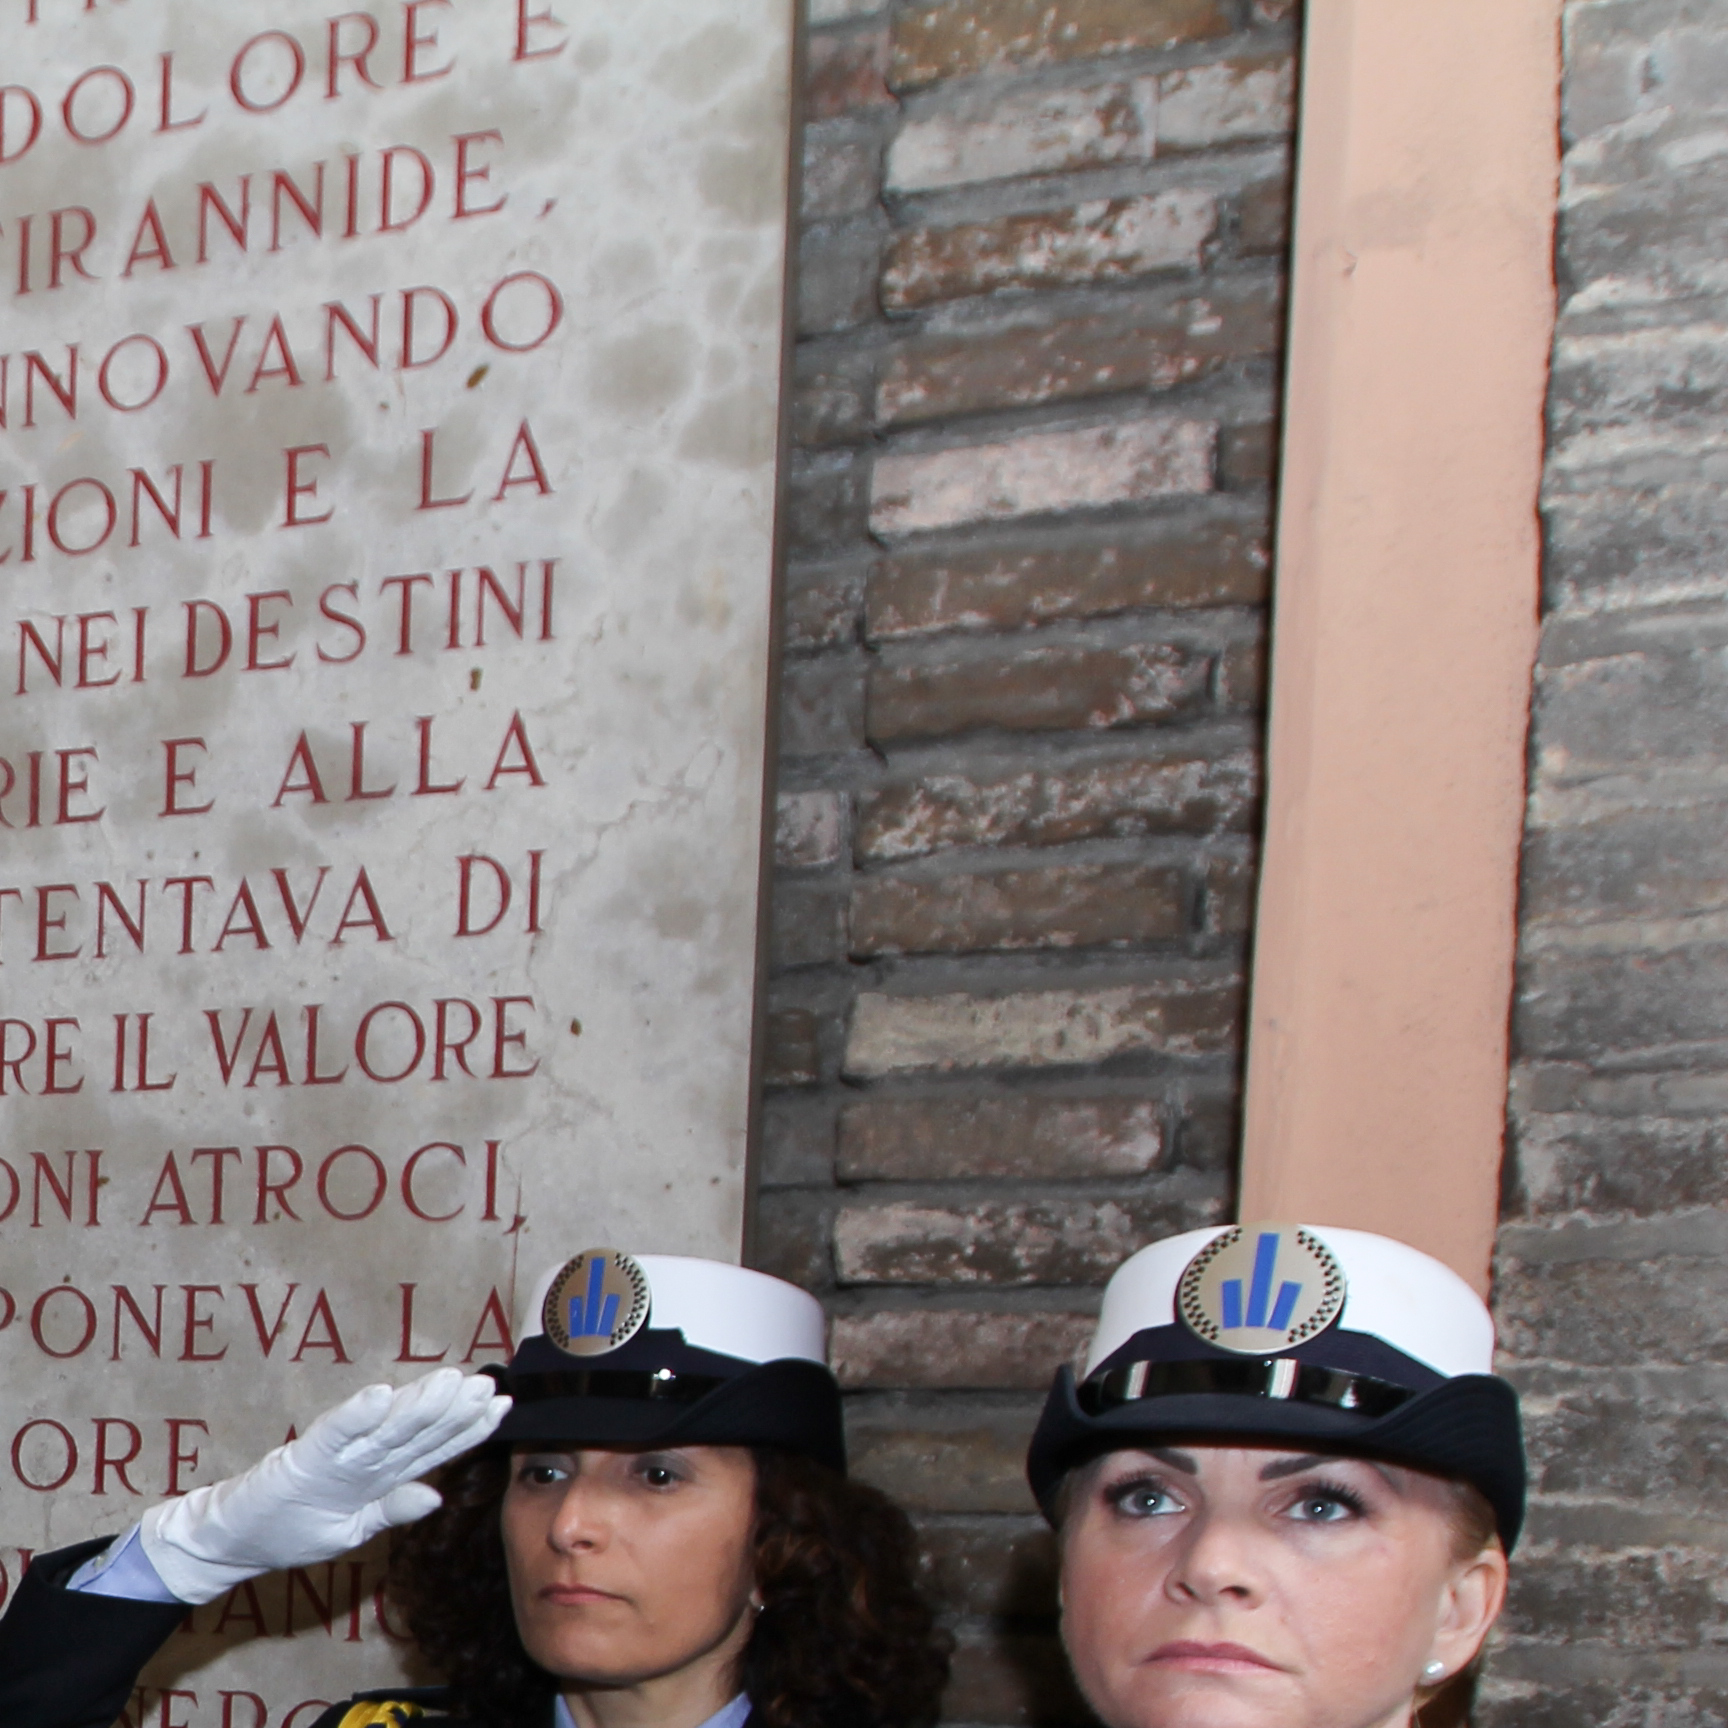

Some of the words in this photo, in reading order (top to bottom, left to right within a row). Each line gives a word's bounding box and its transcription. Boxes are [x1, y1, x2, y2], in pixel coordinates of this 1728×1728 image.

[511, 0, 563, 64] E
[280, 443, 332, 530] E
[415, 421, 551, 513] LA
[14, 608, 148, 697] NEI
[181, 561, 554, 681] DESTINI
[157, 737, 212, 819] E
[271, 711, 545, 808] ALLA
[454, 850, 543, 938] DI
[112, 1014, 176, 1093] IL
[203, 996, 538, 1089] VALORE
[139, 1141, 525, 1234] ATROCI,
[394, 1272, 516, 1365] LA
